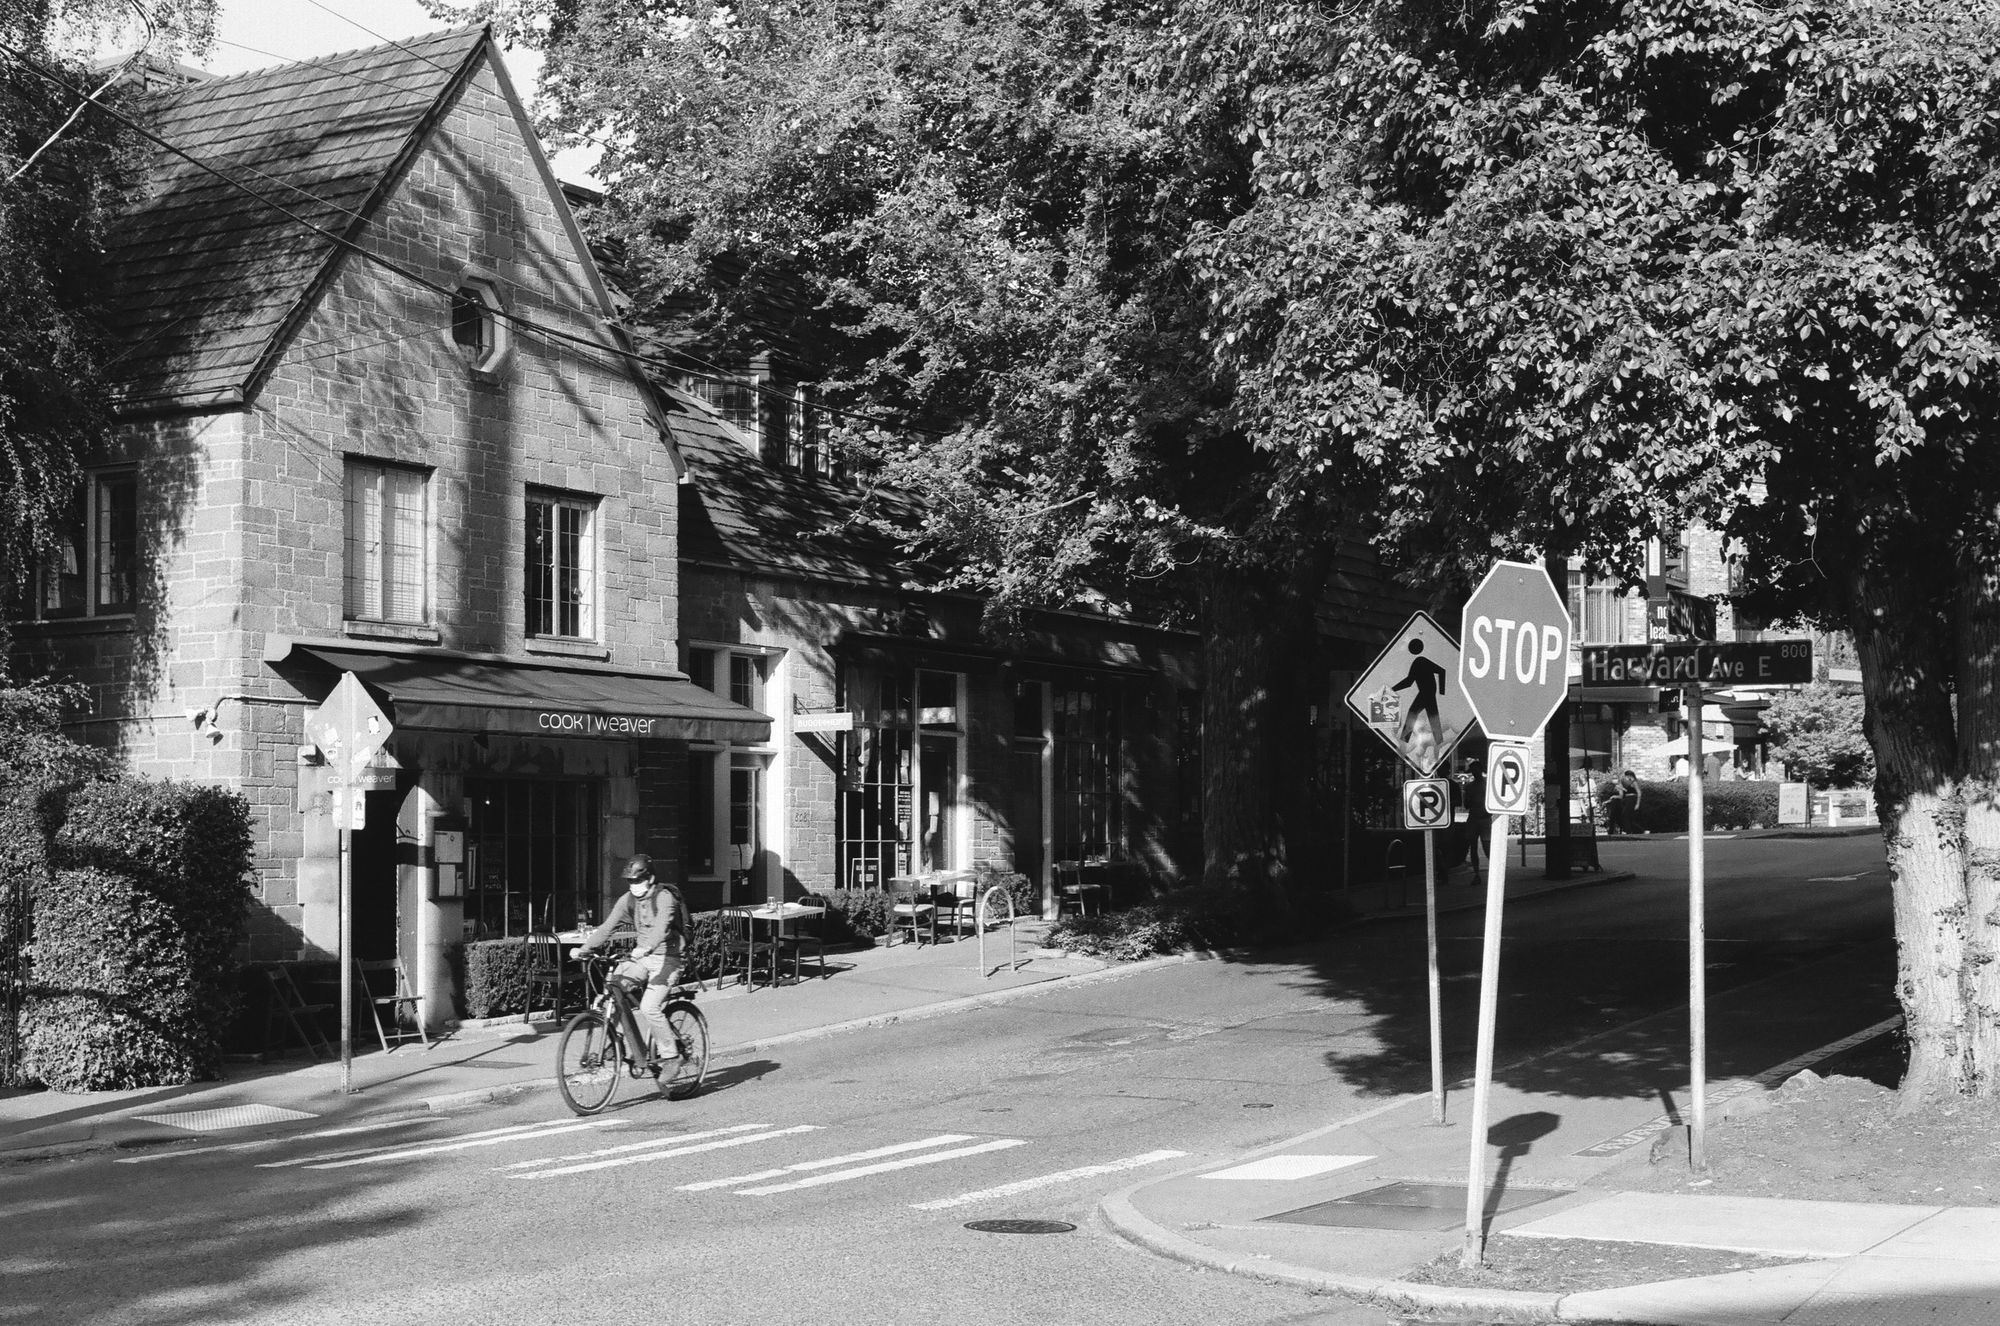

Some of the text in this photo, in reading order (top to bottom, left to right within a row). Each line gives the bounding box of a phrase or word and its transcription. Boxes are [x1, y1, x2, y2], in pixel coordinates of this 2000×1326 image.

[1468, 615, 1563, 685] STOP
[1780, 644, 1808, 658] 800
[1591, 648, 1772, 682] Harvard Ave E
[594, 716, 656, 734] weaver
[357, 774, 395, 784] weaver
